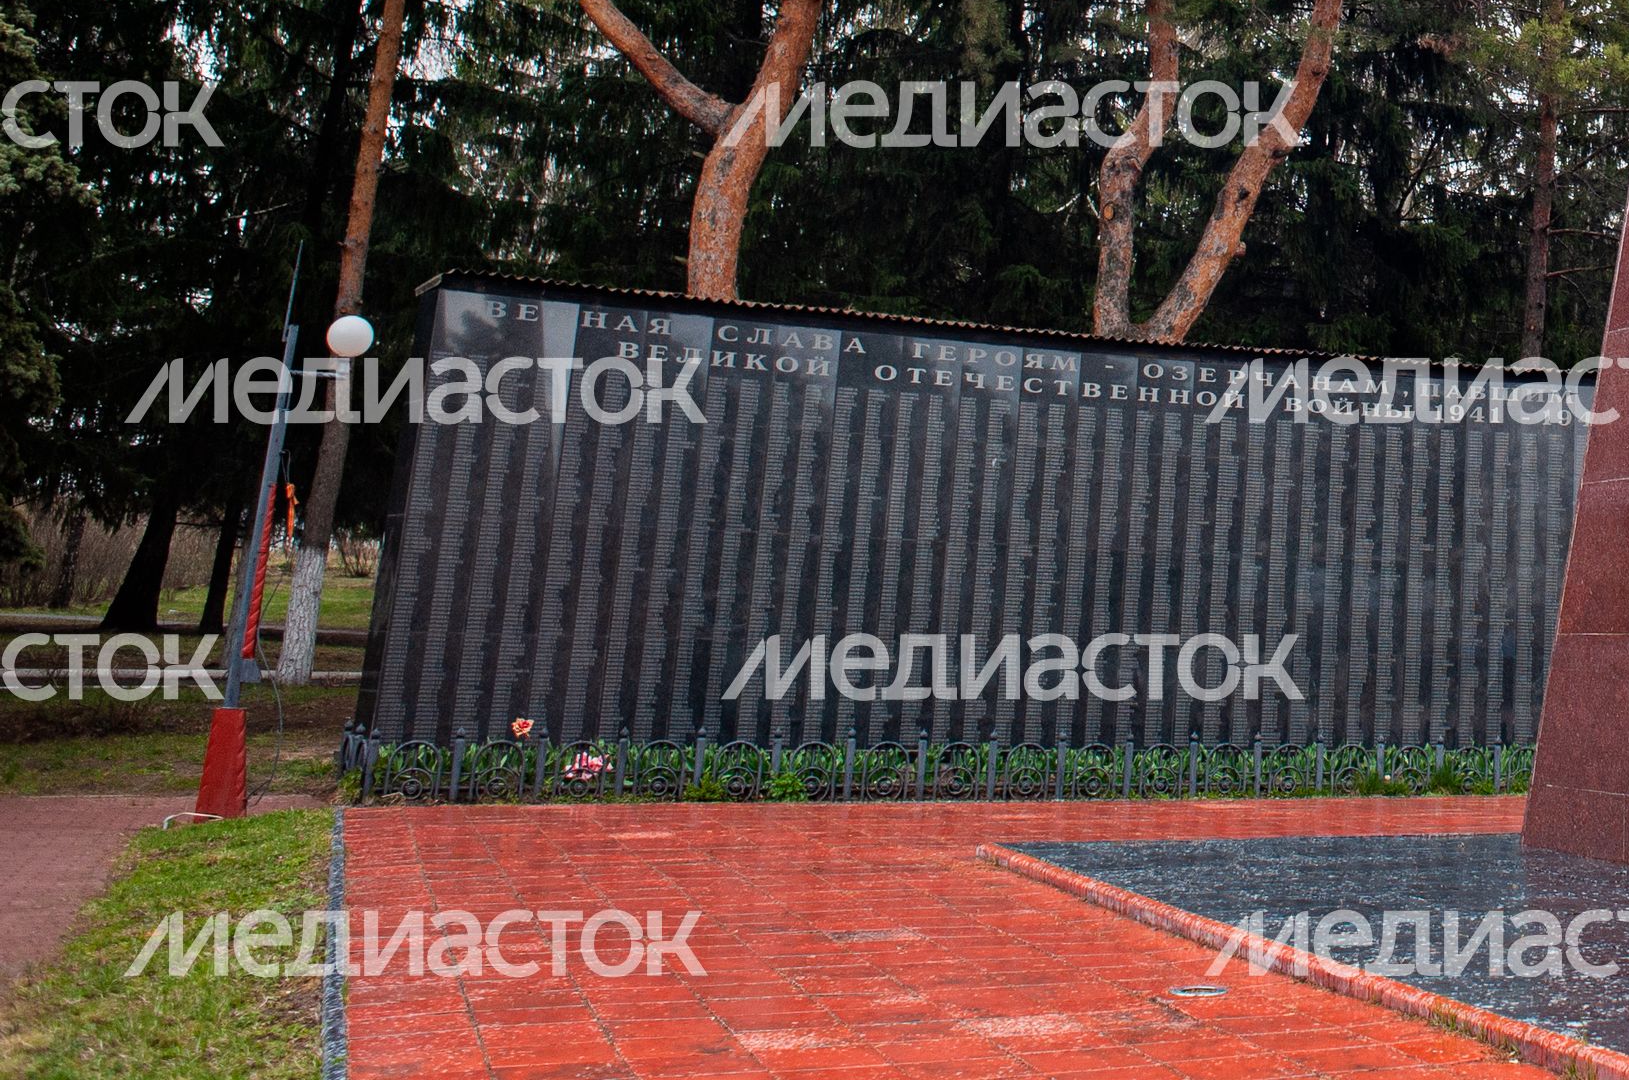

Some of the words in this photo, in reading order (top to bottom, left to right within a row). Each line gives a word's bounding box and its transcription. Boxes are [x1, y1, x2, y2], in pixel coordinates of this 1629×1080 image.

[618, 341, 831, 377] ВЕЛИКОЙ
[875, 365, 1245, 409] ОТЕЧЕСТВЕННОЙ
[1284, 397, 1412, 419] ВОЙНЫ
[1434, 404, 1501, 424] 1941
[717, 325, 866, 354] СЛАВА
[913, 343, 1078, 372] ГЕРОЯМ
[1420, 382, 1575, 404] ПАВШИМ
